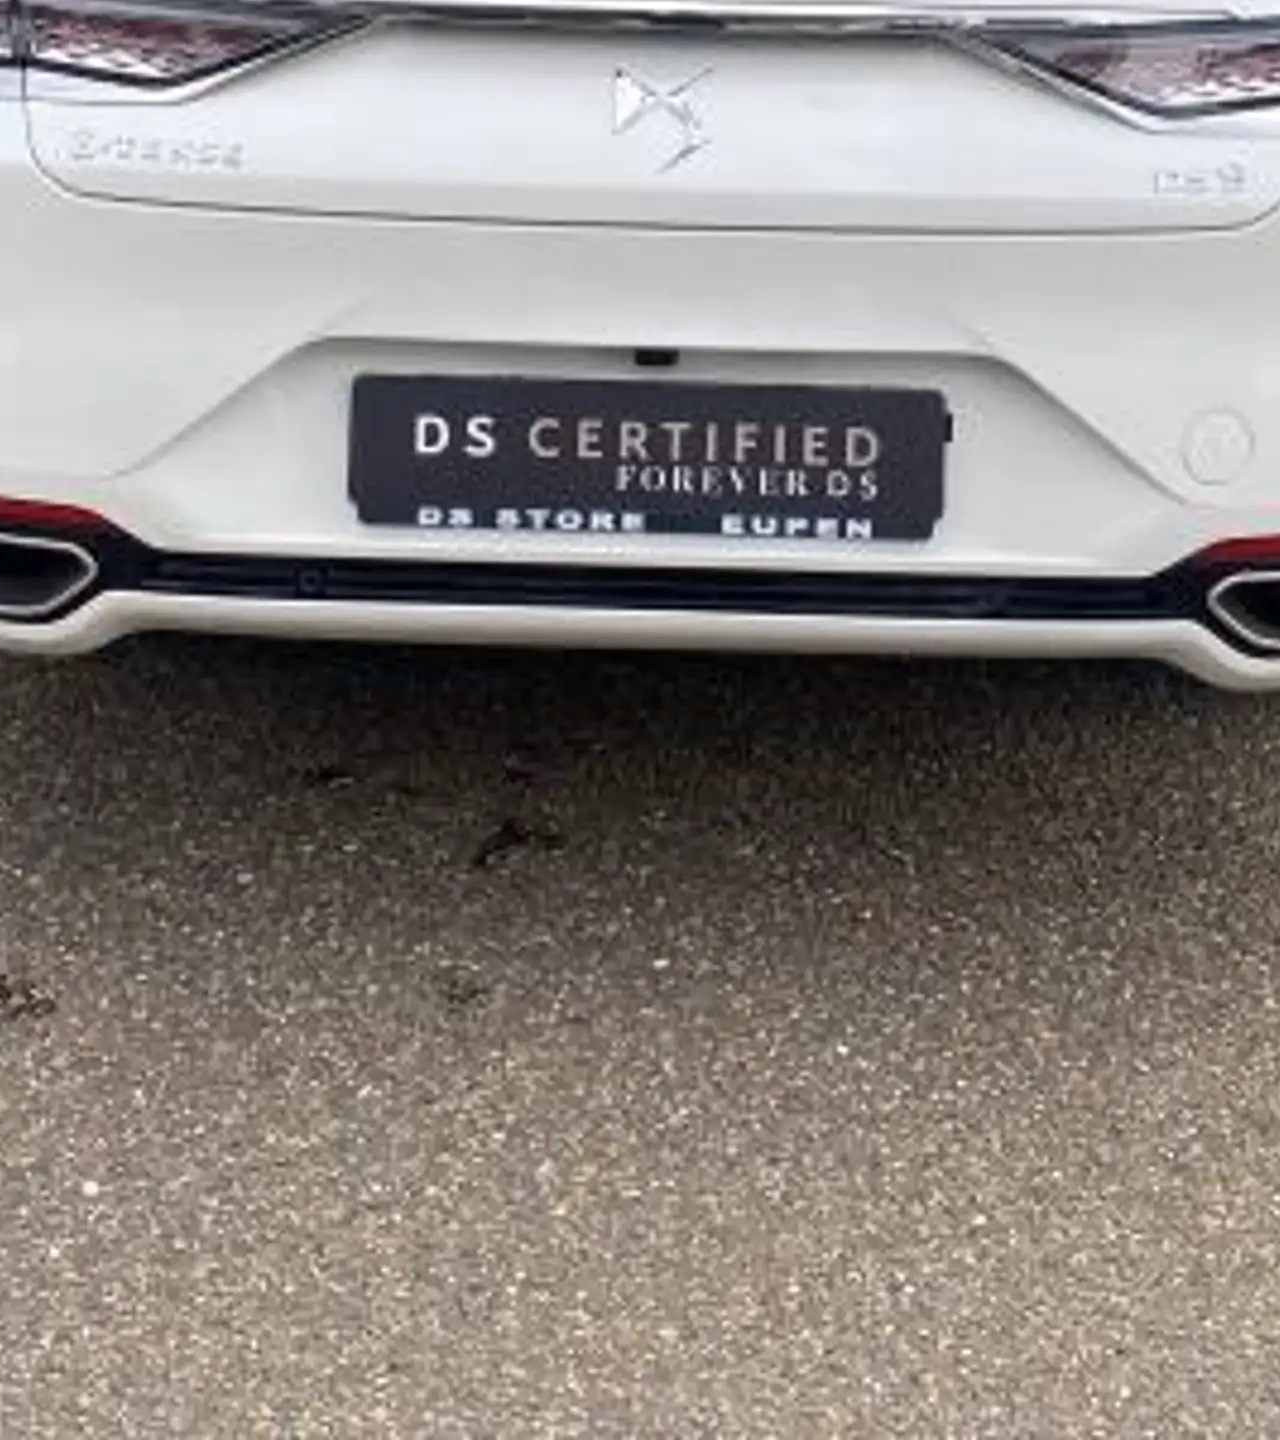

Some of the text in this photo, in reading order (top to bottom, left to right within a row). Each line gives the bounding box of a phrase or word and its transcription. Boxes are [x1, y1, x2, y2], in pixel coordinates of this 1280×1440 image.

[413, 415, 880, 468] DS CERTIFIED
[614, 463, 880, 502] FOREVER DS
[495, 507, 646, 533] STORE
[720, 512, 873, 540] EUPEN
